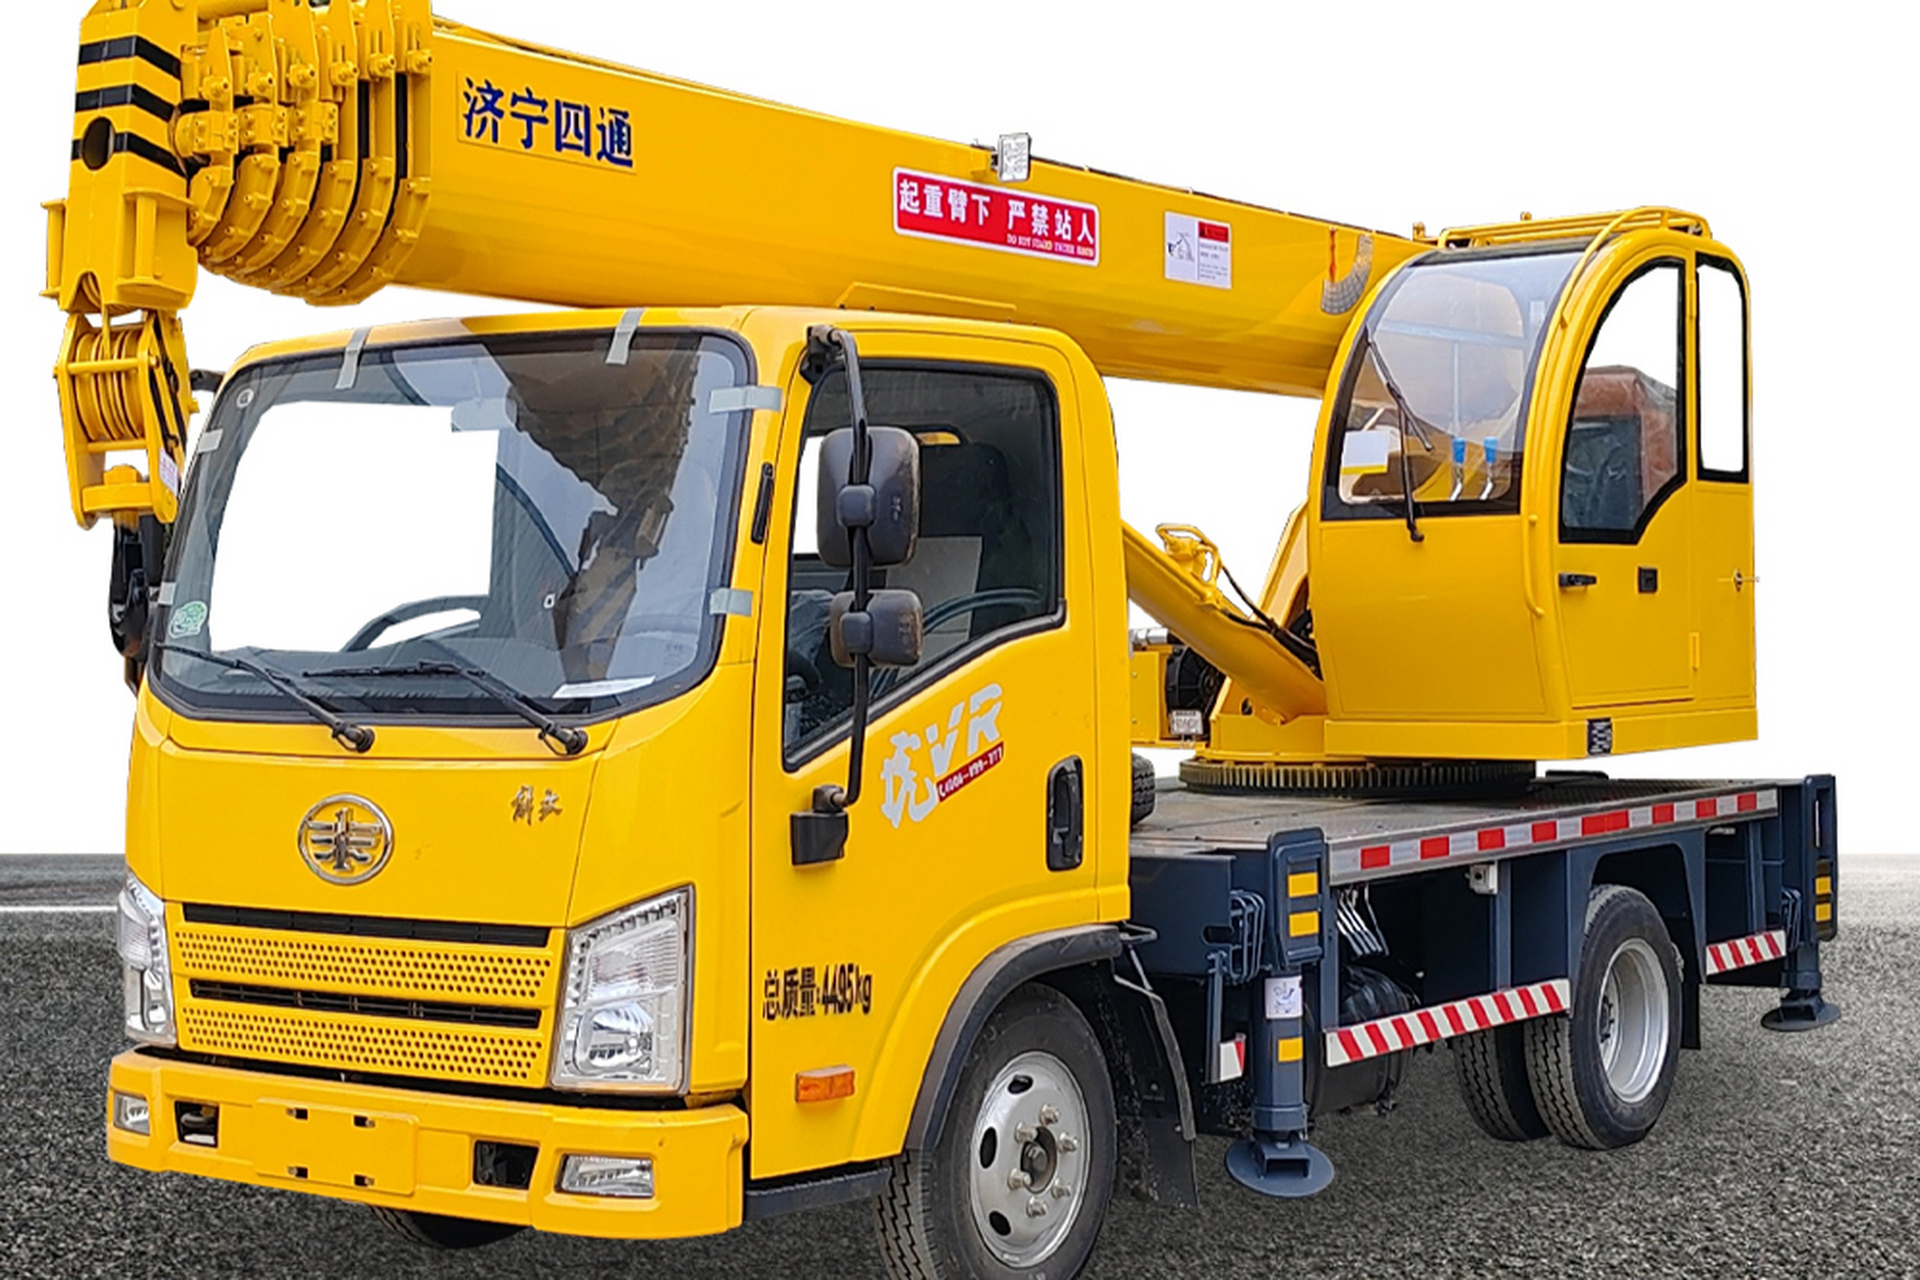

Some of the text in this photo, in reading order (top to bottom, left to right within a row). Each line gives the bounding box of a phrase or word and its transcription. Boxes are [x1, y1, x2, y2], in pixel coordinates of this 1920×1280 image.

[463, 78, 634, 168] 济宁四通
[899, 179, 1094, 244] 起重臂下 严禁站人
